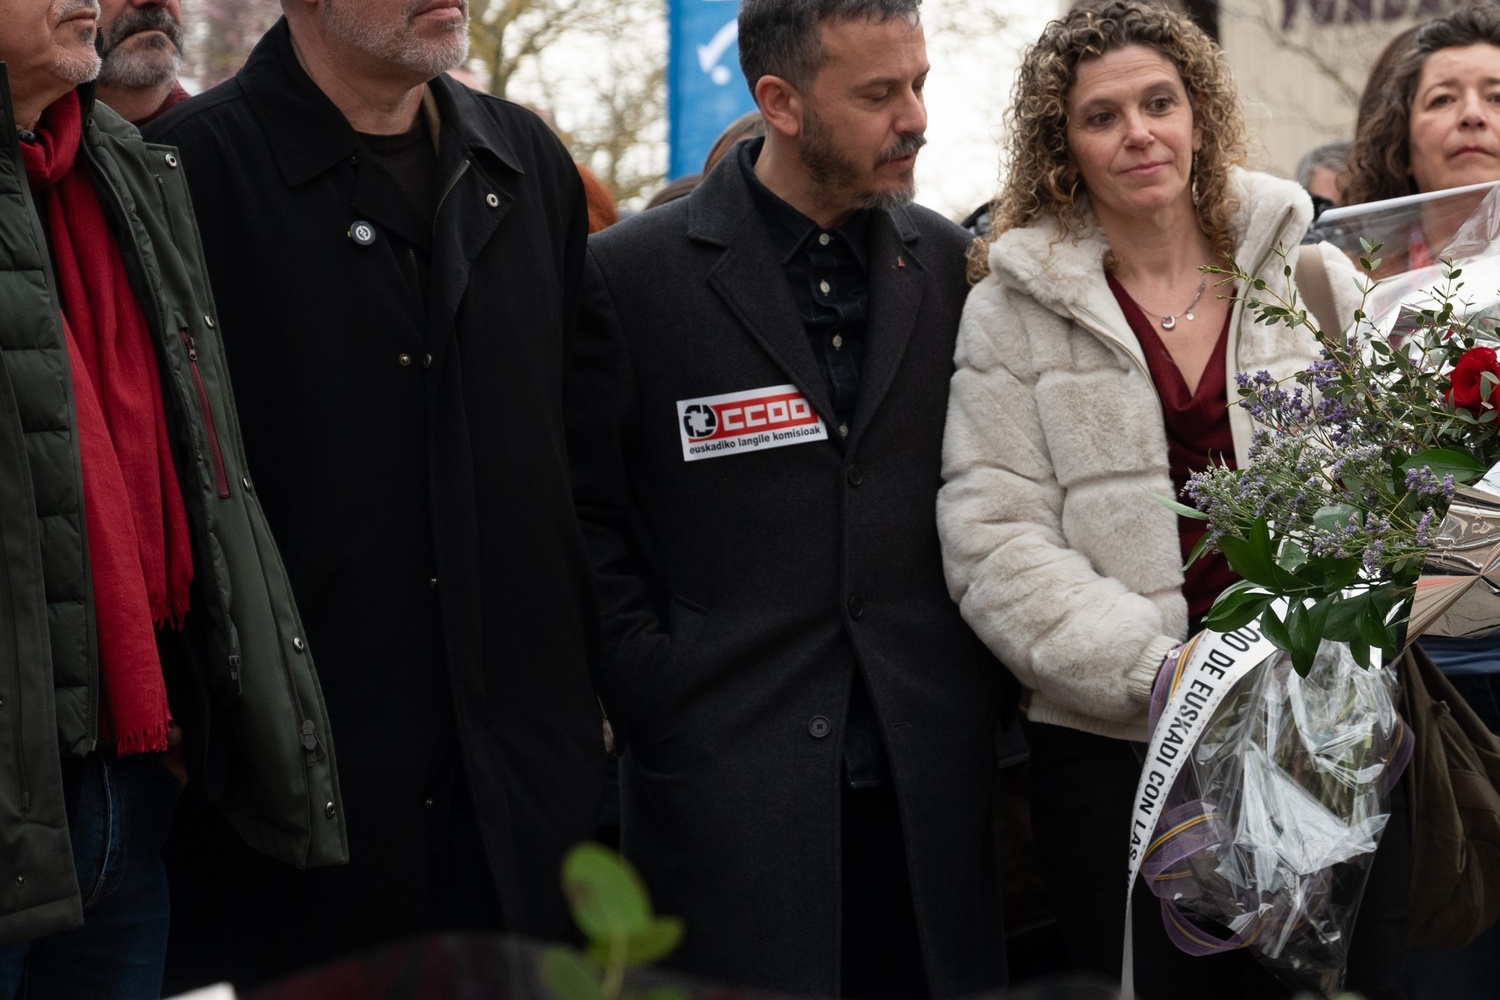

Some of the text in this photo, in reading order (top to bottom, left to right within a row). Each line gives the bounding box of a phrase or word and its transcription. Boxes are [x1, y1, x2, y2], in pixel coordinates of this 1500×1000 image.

[721, 398, 812, 431] CCOO
[689, 425, 821, 455] euskadiko langile komisioak
[1200, 648, 1235, 680] DE
[1156, 679, 1214, 767] EUSKADI
[1139, 770, 1165, 815] CON
[1129, 819, 1146, 861] LAS
